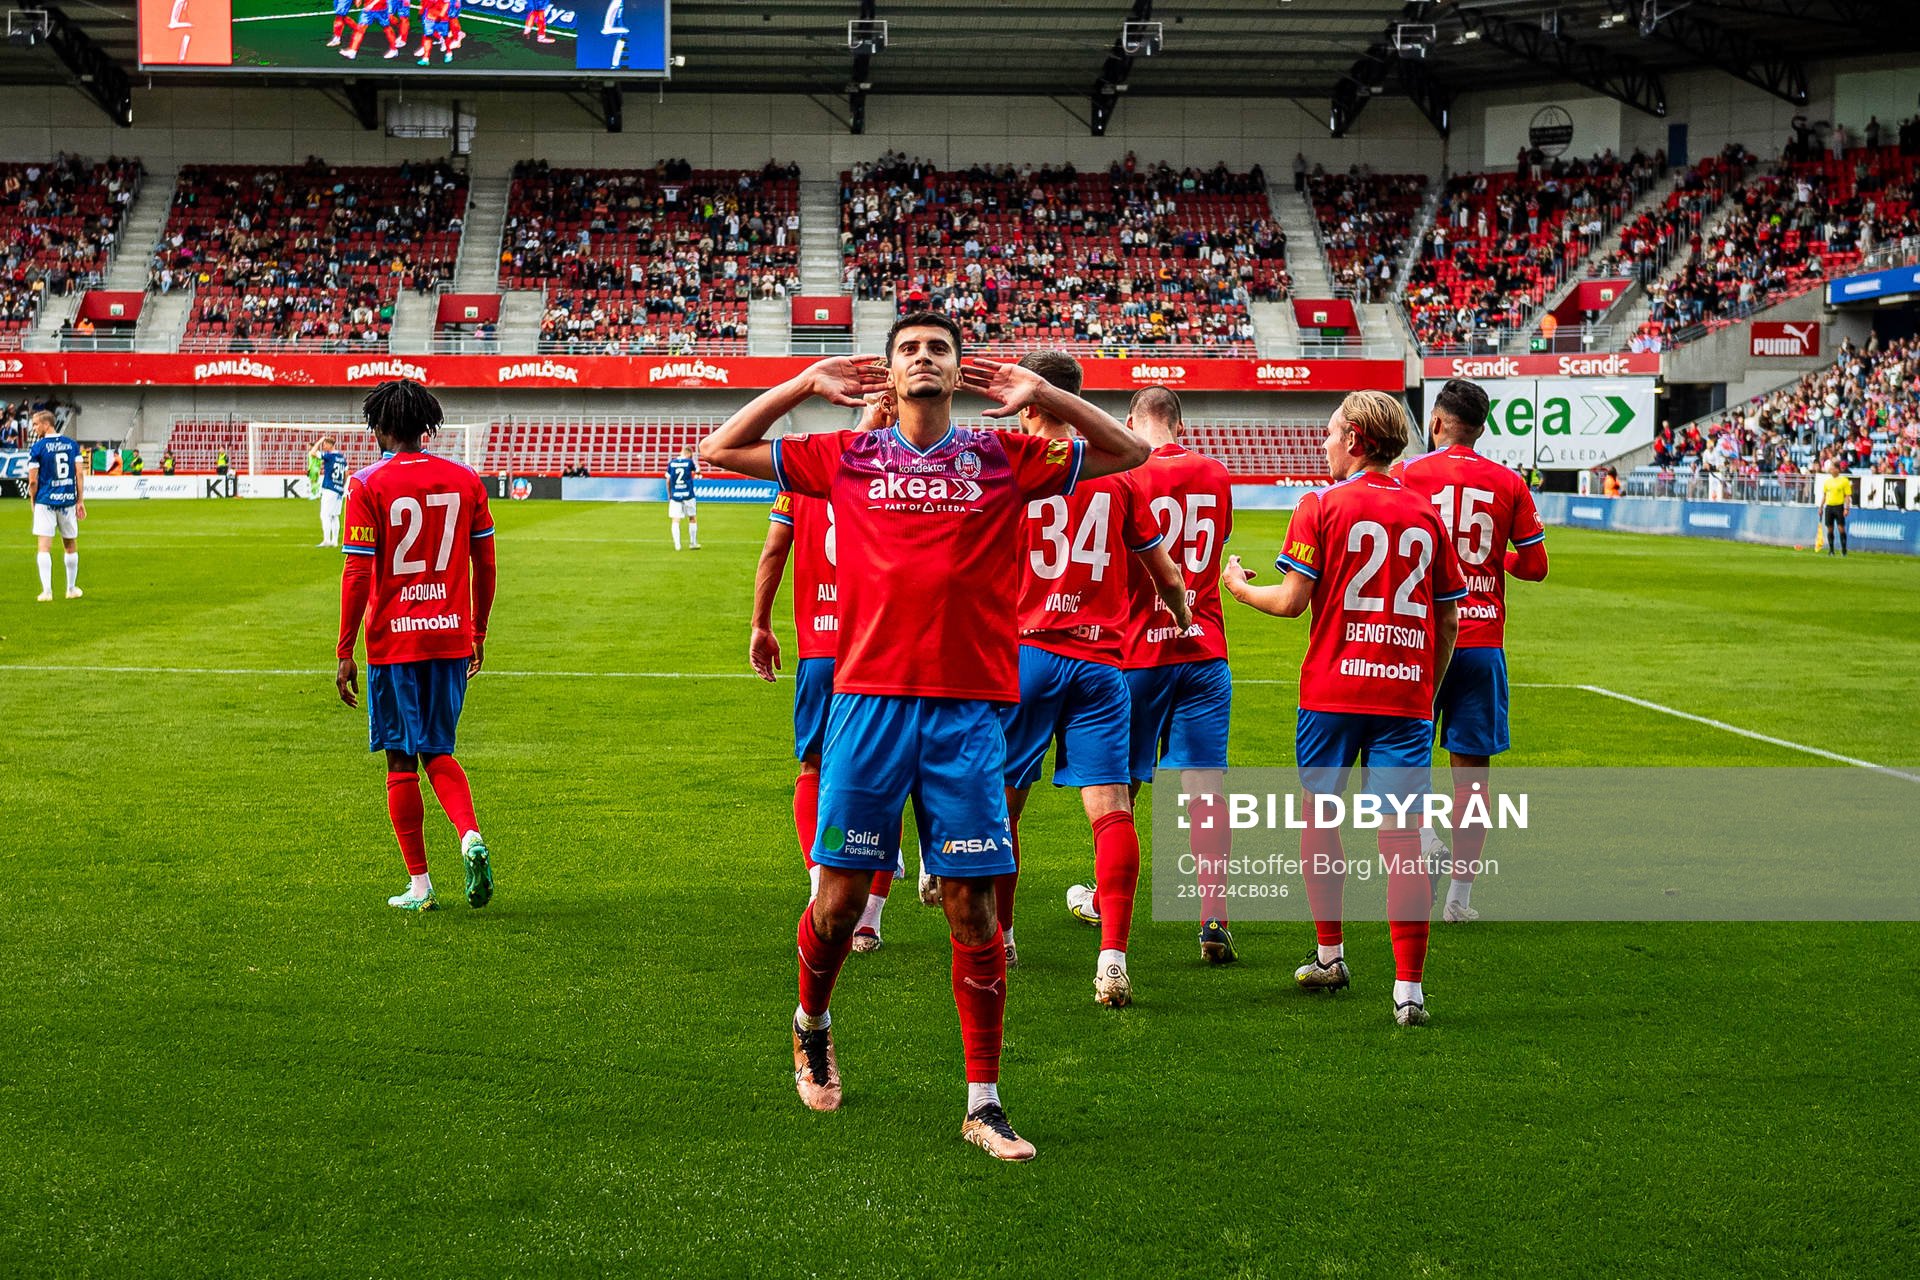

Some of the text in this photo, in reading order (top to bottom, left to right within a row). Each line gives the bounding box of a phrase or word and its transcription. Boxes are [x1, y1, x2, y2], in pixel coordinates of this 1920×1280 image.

[1753, 338, 1800, 355] PUMA
[194, 359, 274, 381] RAMLÖSA
[347, 359, 425, 382] RAMLÖSA
[499, 359, 577, 383] RAMLÖSA
[649, 359, 728, 383] RAMLÖSA
[1132, 363, 1169, 379] akea
[1257, 364, 1294, 379] akea
[1452, 357, 1519, 377] Scandic
[1558, 354, 1630, 375] Scandic
[1487, 397, 1572, 436] kea
[55, 452, 70, 479] 6
[1560, 449, 1607, 461] ELEDA
[675, 468, 685, 483] 2
[899, 464, 946, 473] kondektor
[868, 472, 948, 499] akea
[937, 505, 966, 513] ELEDA
[350, 526, 375, 543] XXL
[390, 492, 461, 575] 27
[1150, 494, 1216, 574] 25
[1431, 485, 1494, 565] 15
[1028, 492, 1111, 581] 34
[1289, 540, 1316, 565] XXL
[1344, 520, 1433, 619] 22
[400, 583, 447, 602] ACQUAH
[1464, 576, 1495, 593] MAWI
[1045, 591, 1081, 613] VAGIĆ
[1457, 604, 1496, 619] mobil
[391, 614, 459, 632] tillmobil
[1346, 622, 1425, 649] BENGTSSON
[1340, 658, 1421, 681] tillmobil
[847, 829, 880, 846] Solid
[951, 838, 998, 854] RSA
[845, 844, 885, 859] Försäkring
